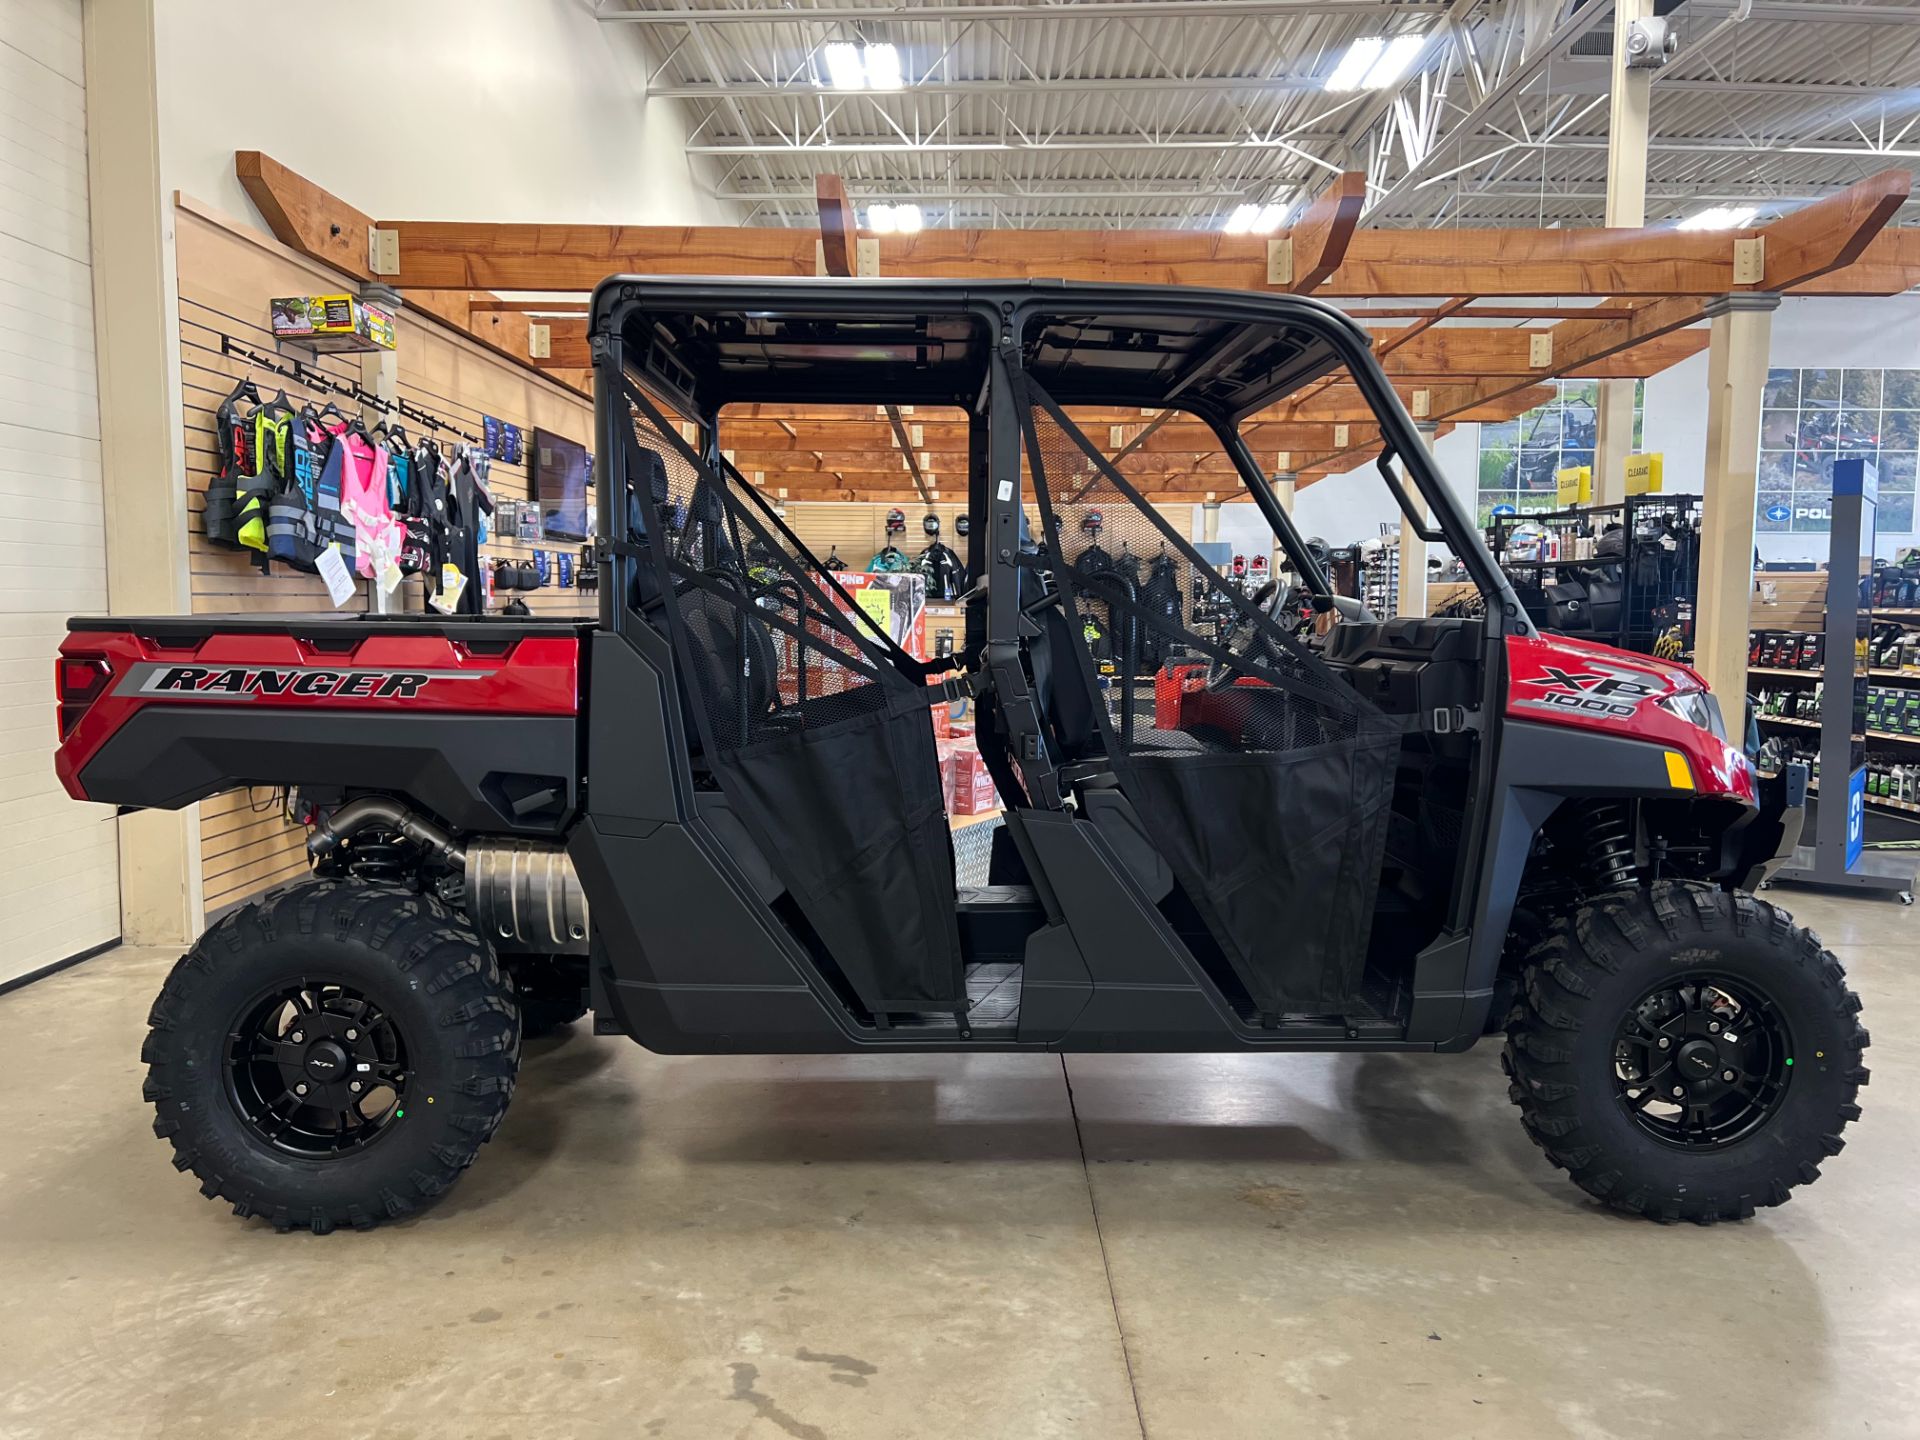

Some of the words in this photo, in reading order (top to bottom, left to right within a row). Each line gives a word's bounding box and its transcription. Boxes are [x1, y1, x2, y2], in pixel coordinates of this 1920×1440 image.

[153, 667, 430, 698] RANGER
[1520, 665, 1654, 696] XP
[1543, 692, 1638, 717] 1000
